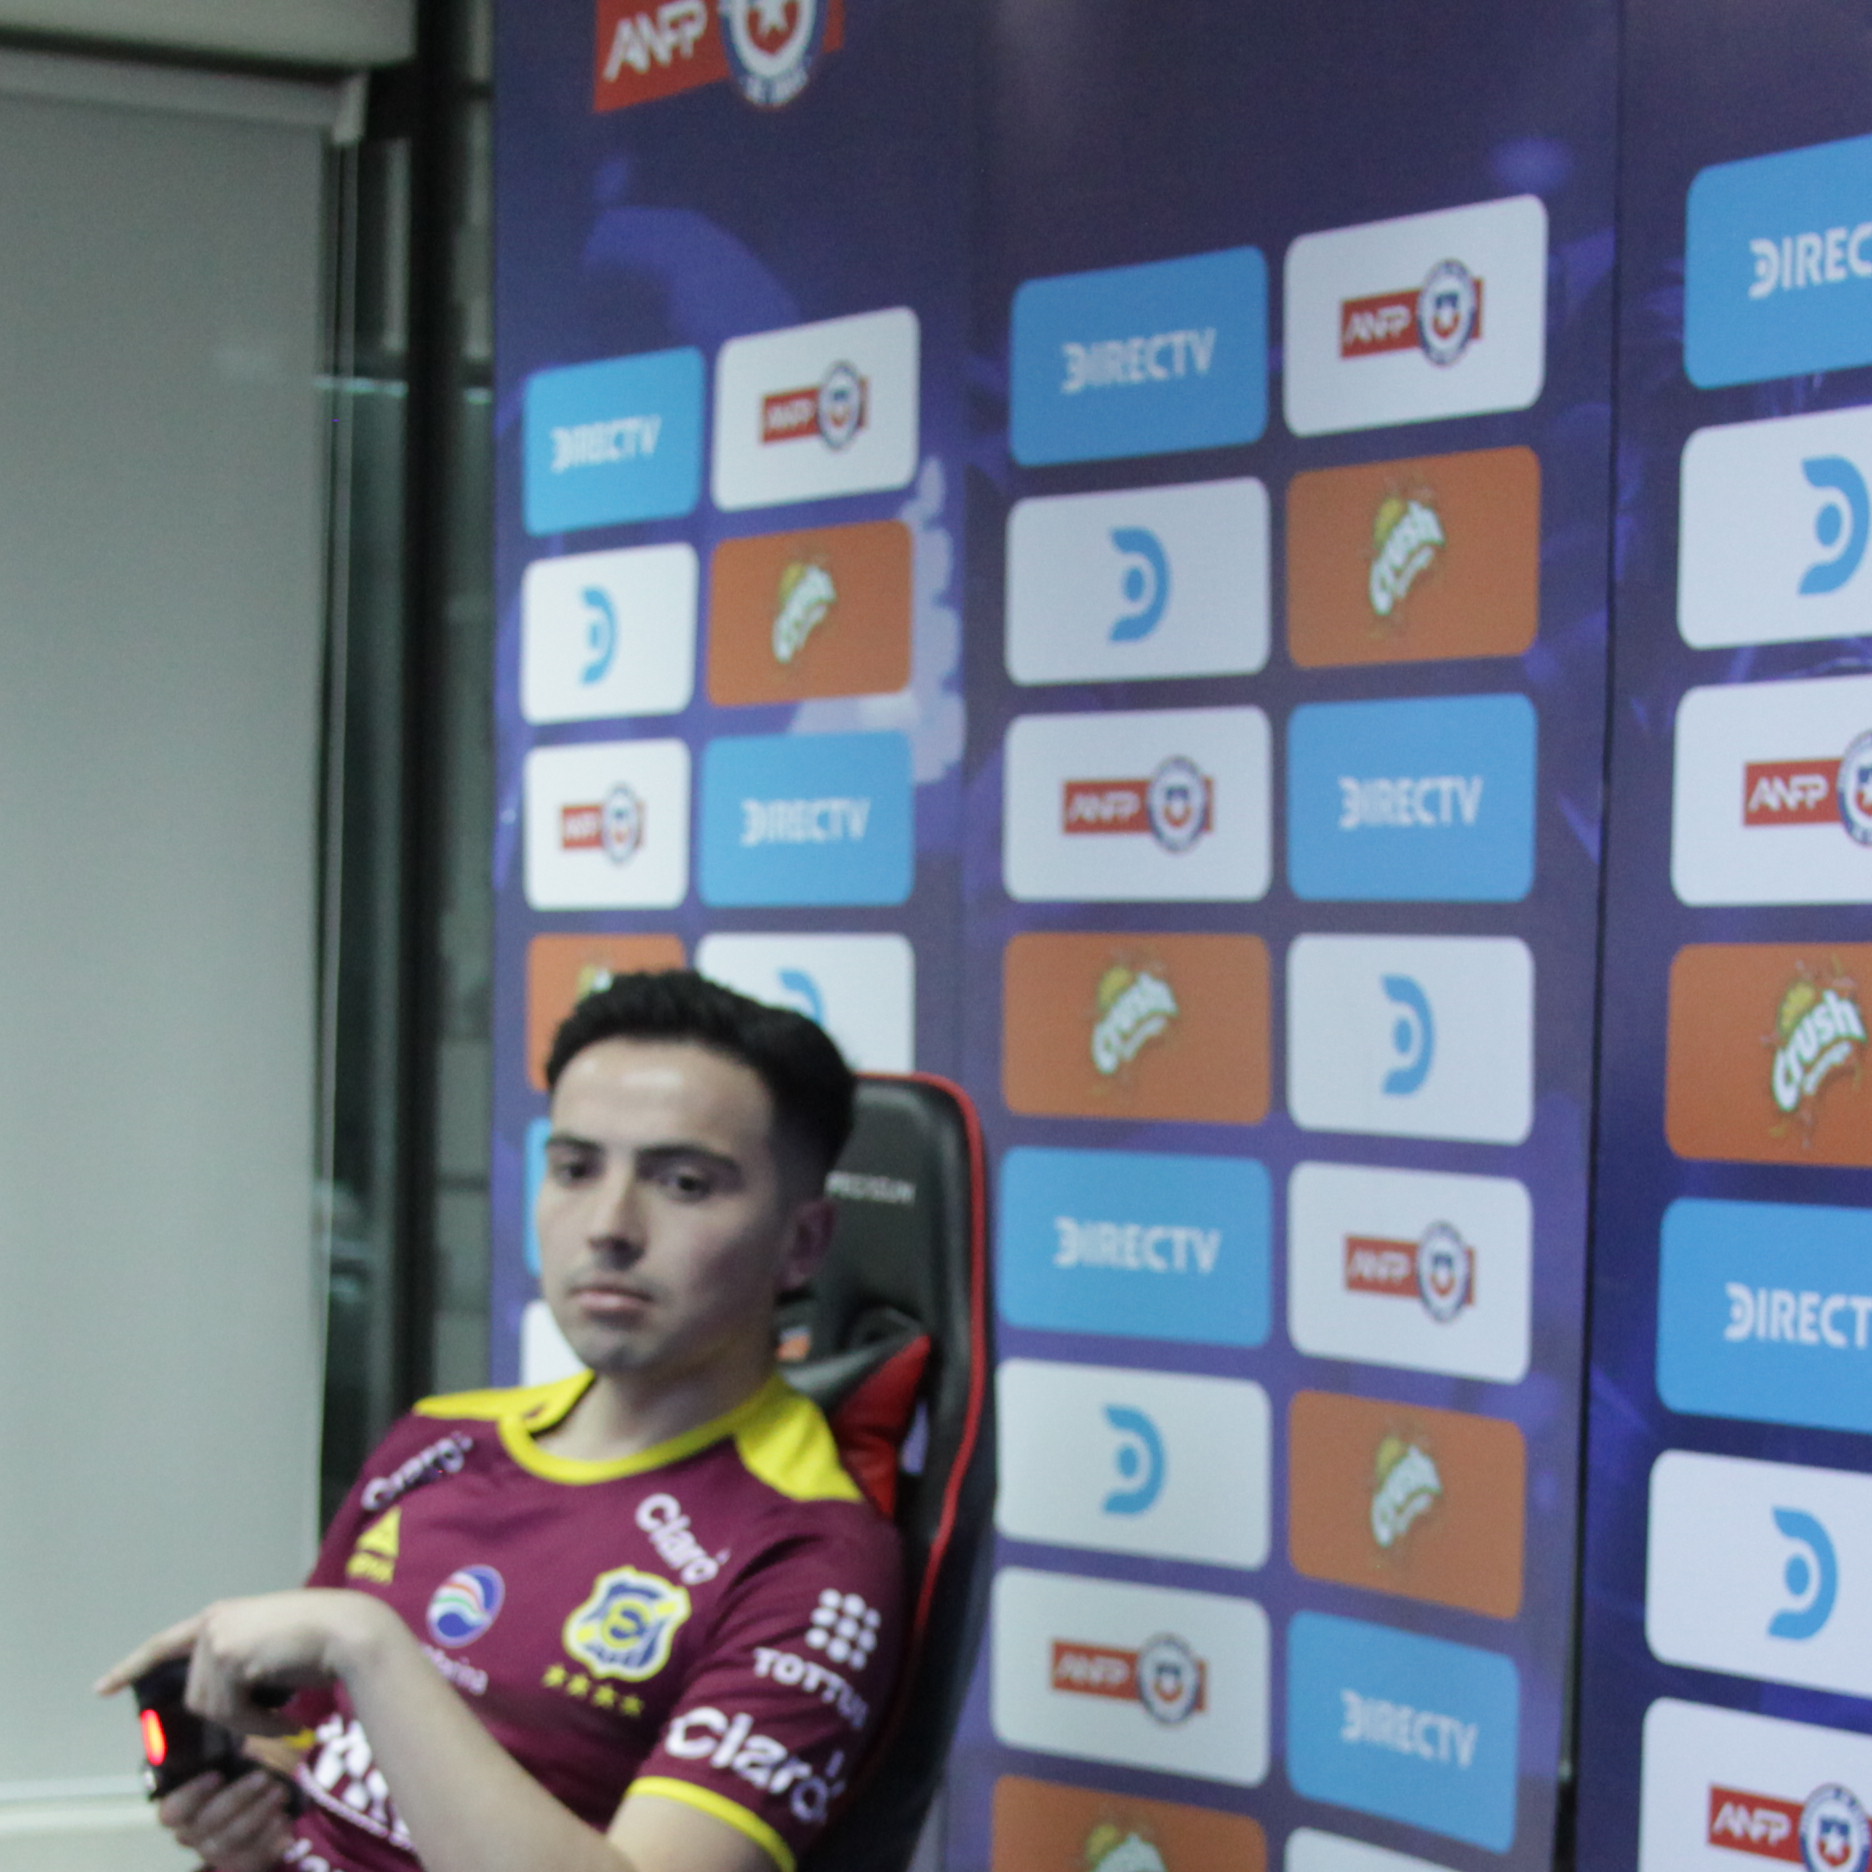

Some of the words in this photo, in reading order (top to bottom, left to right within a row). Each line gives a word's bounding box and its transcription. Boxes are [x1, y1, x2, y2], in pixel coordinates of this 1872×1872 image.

[1060, 325, 1216, 396] DIRECTV
[739, 795, 871, 847] DIRECTV
[1339, 773, 1483, 832] DIRECTV
[1748, 774, 1828, 812] ANFP
[1054, 1214, 1221, 1274] DIRECTV
[1340, 1690, 1480, 1769] DIRECTV
[1713, 1801, 1792, 1846] ANFP
